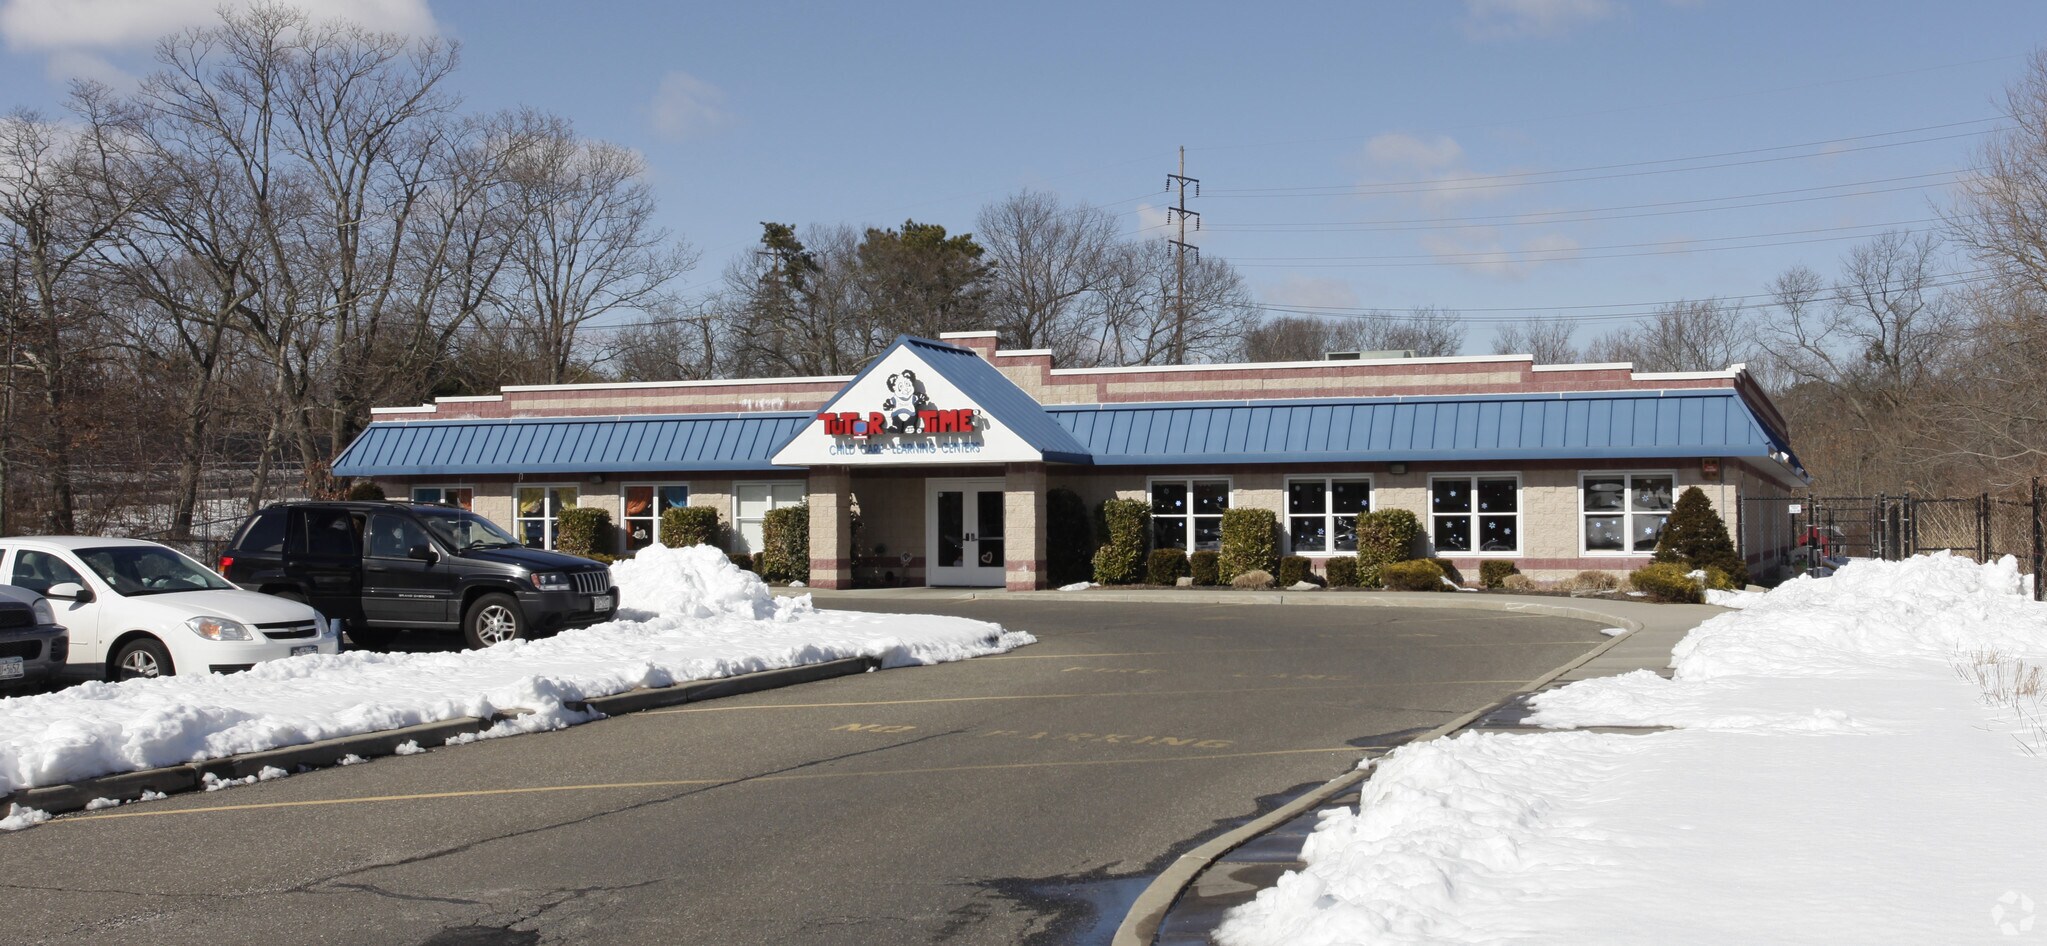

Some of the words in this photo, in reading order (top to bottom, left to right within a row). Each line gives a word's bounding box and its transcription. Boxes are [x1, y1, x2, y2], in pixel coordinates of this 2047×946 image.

[829, 444, 858, 456] CHILD
[891, 441, 936, 455] LEARNING
[941, 440, 982, 455] CENTERS
[829, 722, 917, 733] NO
